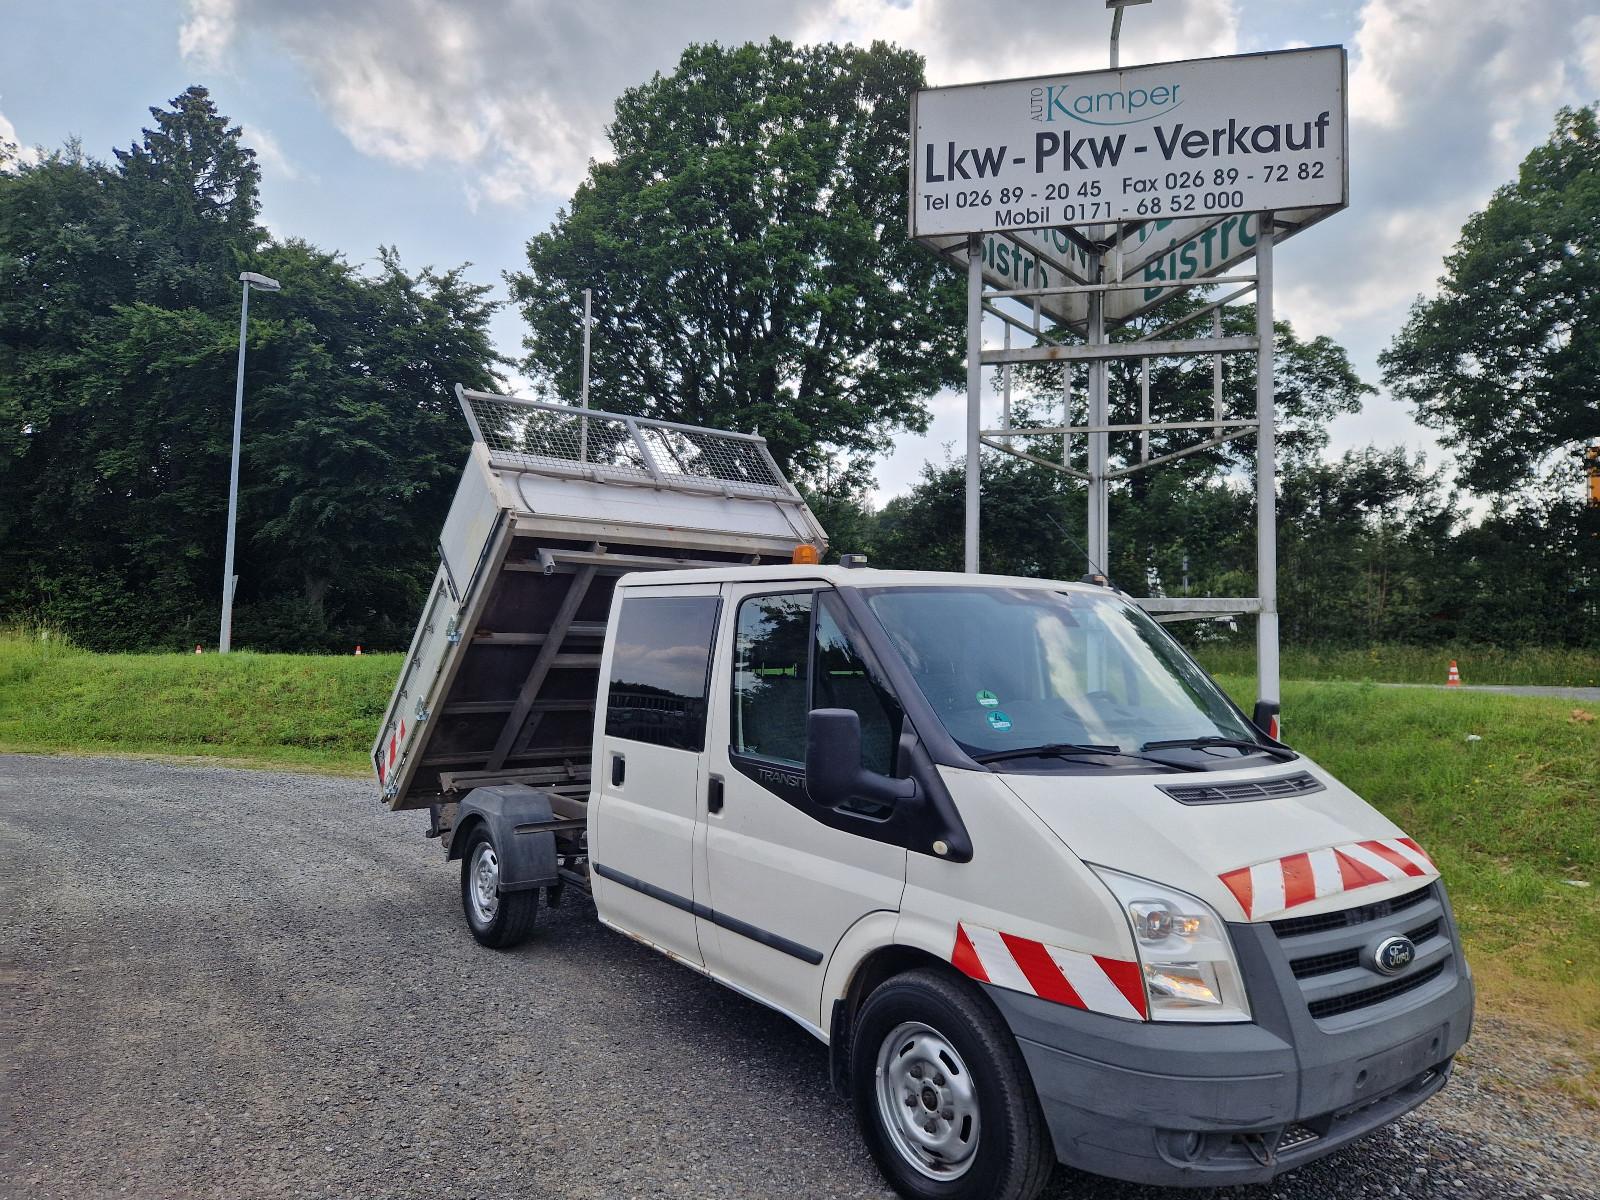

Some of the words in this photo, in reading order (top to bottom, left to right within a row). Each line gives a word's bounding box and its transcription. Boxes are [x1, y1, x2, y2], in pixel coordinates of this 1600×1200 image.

[1031, 87, 1043, 122] AUTO
[1045, 84, 1182, 124] Kamper
[1153, 111, 1330, 161] Verkauf
[924, 193, 949, 211] Tel
[956, 189, 993, 209] 026
[999, 186, 1024, 205] 89
[1045, 183, 1070, 201] 20
[1077, 180, 1102, 198] 45
[1122, 177, 1159, 194] Fax
[1165, 170, 1205, 190] 026
[1213, 168, 1240, 186] 89
[1263, 164, 1289, 183] 72
[1297, 161, 1325, 180] 82
[995, 206, 1050, 227] Mobil
[1063, 201, 1112, 222] 0171
[1136, 197, 1162, 216] 68
[1170, 193, 1196, 212] 52
[1203, 190, 1244, 209] 000
[1389, 944, 1410, 966] Ford
